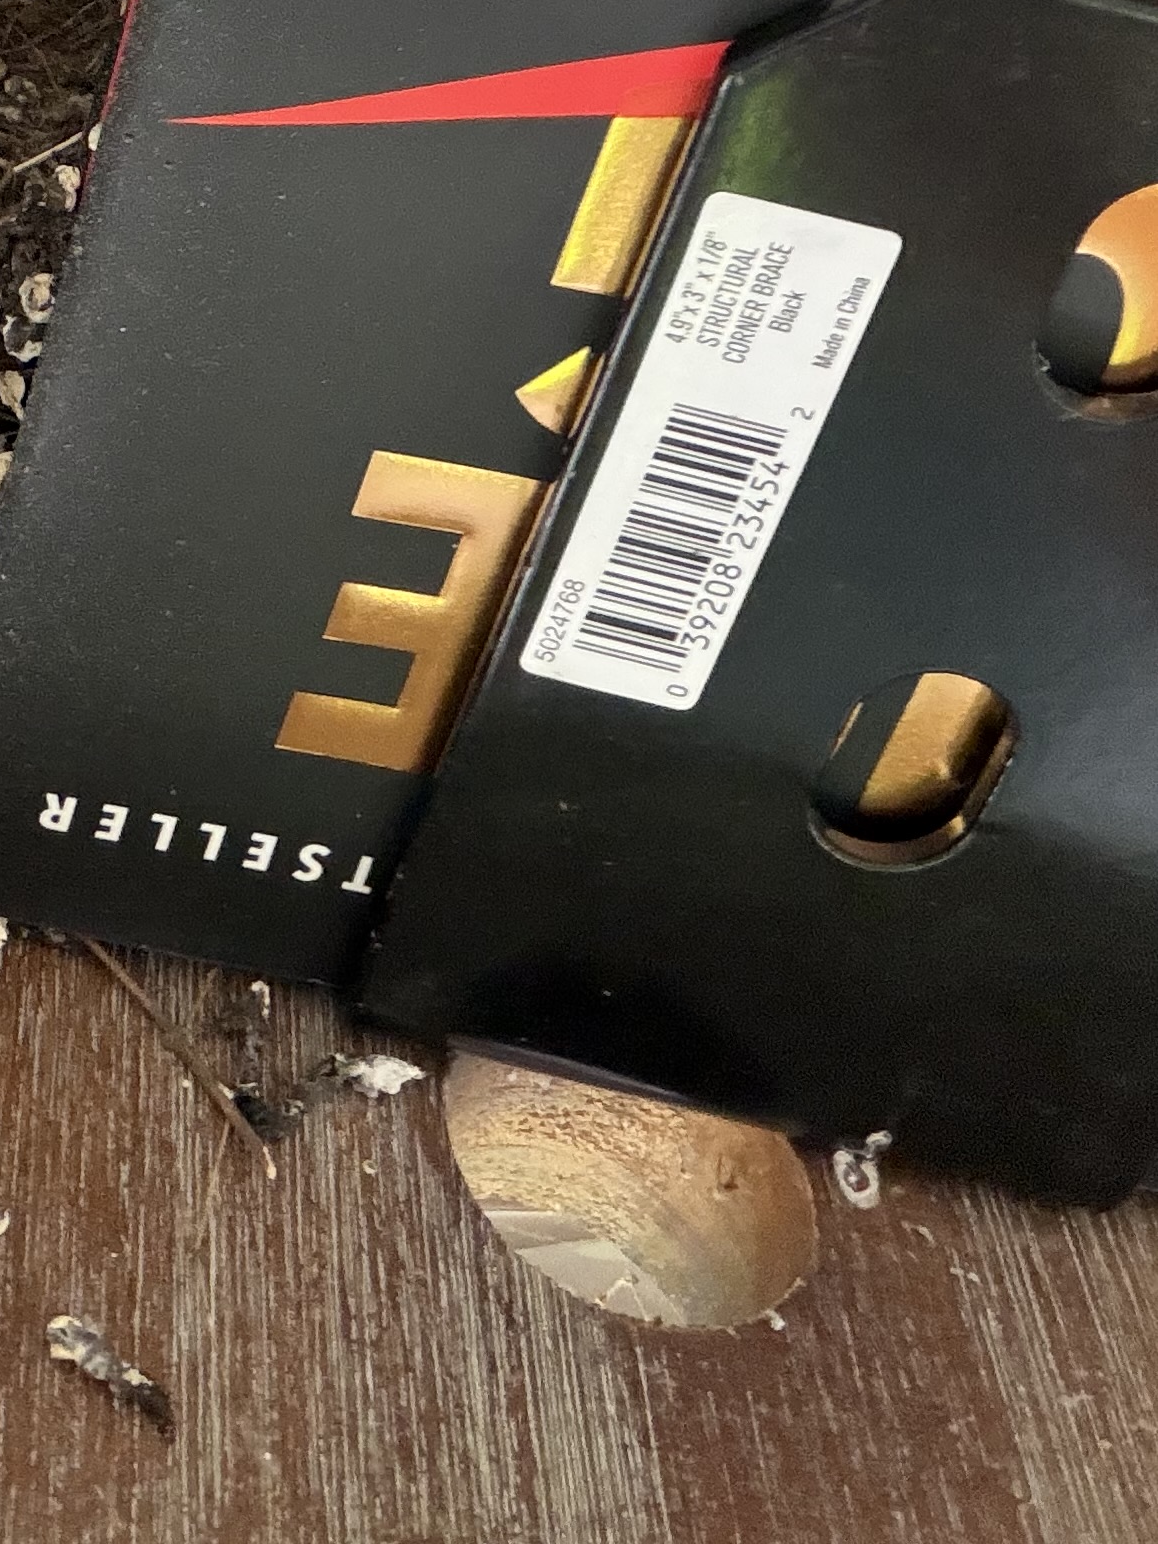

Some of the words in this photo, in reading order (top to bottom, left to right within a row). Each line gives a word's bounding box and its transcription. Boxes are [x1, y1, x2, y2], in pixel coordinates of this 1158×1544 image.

[698, 231, 728, 265] 1/8"
[696, 247, 761, 348] STRUCTURAL
[722, 298, 770, 364] CORNER
[751, 241, 795, 297] BRACE
[767, 290, 807, 333] Black
[836, 276, 871, 315] China
[834, 318, 853, 332] in
[810, 332, 846, 370] Made
[681, 561, 743, 651] 39208
[726, 457, 791, 551] 23454
[535, 578, 587, 663] 5024768
